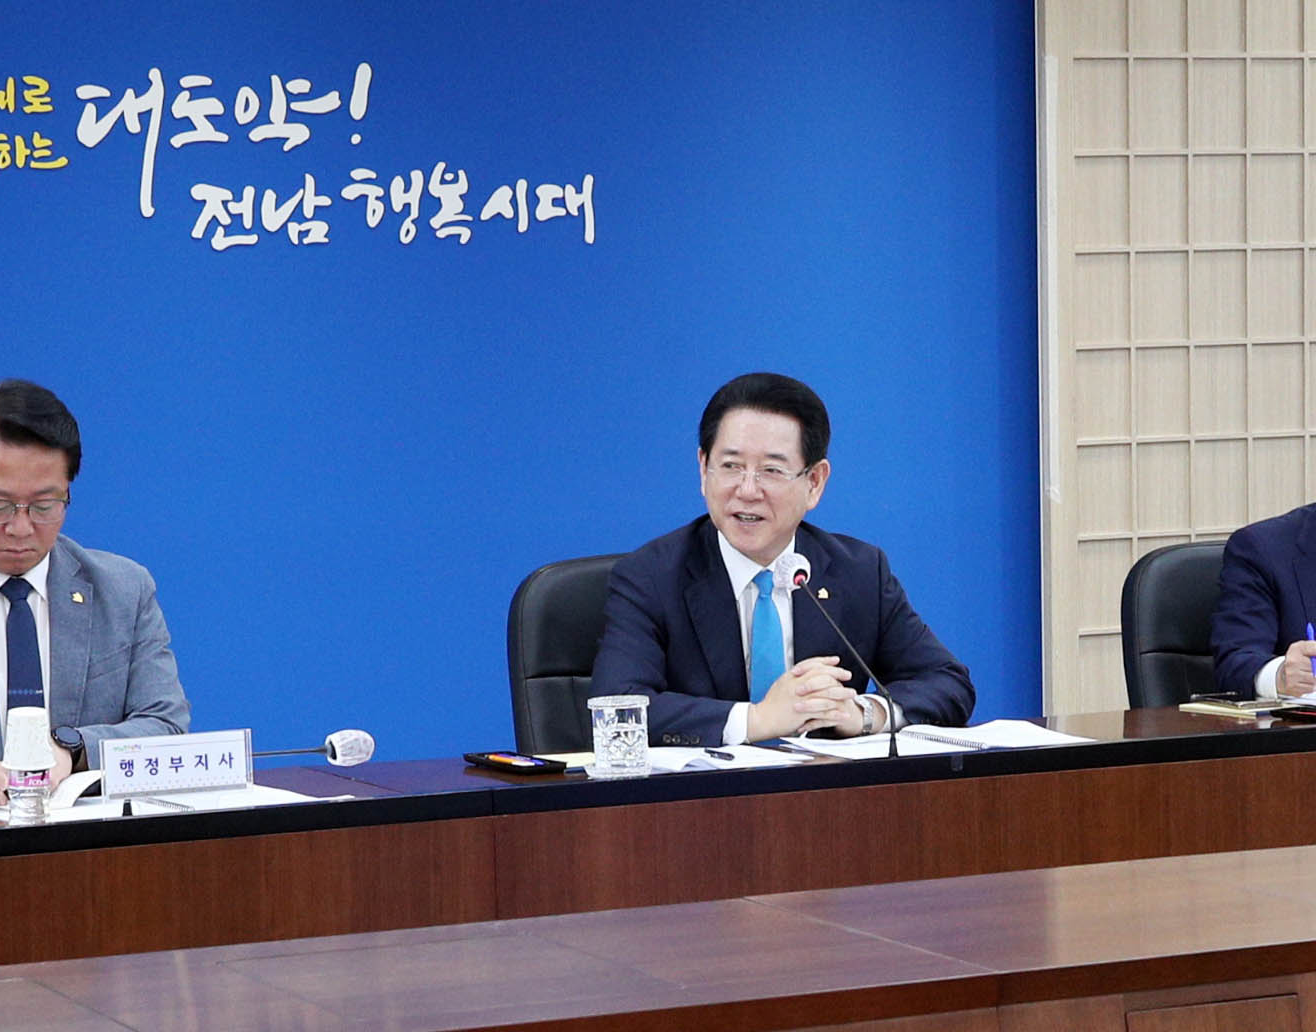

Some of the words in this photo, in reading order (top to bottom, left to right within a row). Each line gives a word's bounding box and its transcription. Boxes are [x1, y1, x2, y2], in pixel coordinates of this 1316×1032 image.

[75, 62, 373, 218] 대도약!
[190, 174, 333, 251] 전남
[119, 751, 234, 778] 행정부지사
